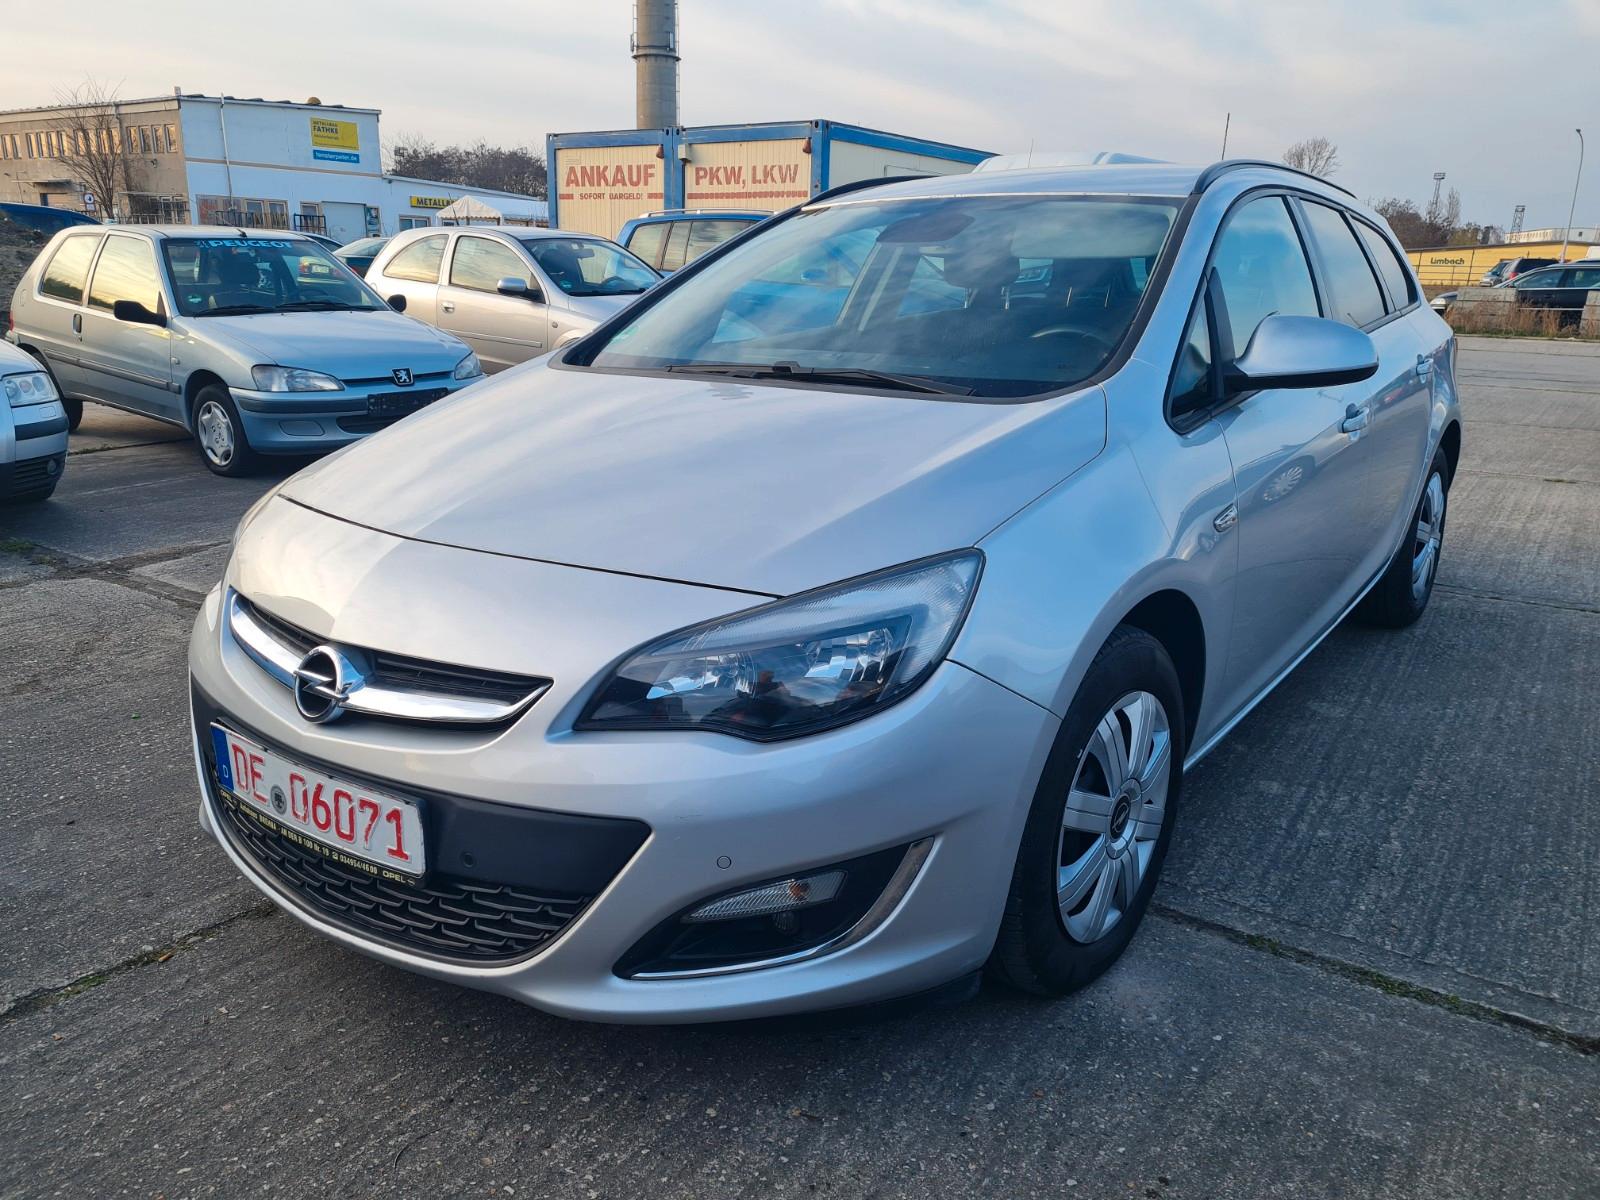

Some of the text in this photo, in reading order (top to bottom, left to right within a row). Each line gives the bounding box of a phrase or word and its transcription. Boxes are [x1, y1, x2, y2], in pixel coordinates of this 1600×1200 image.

[565, 164, 655, 187] ANKAUF
[695, 164, 799, 189] PKW, LKW
[209, 240, 294, 249] PEUGEOT
[1430, 257, 1465, 265] Limbach
[222, 764, 229, 778] D
[231, 743, 412, 862] DE 06071
[382, 870, 406, 883] OPEL
